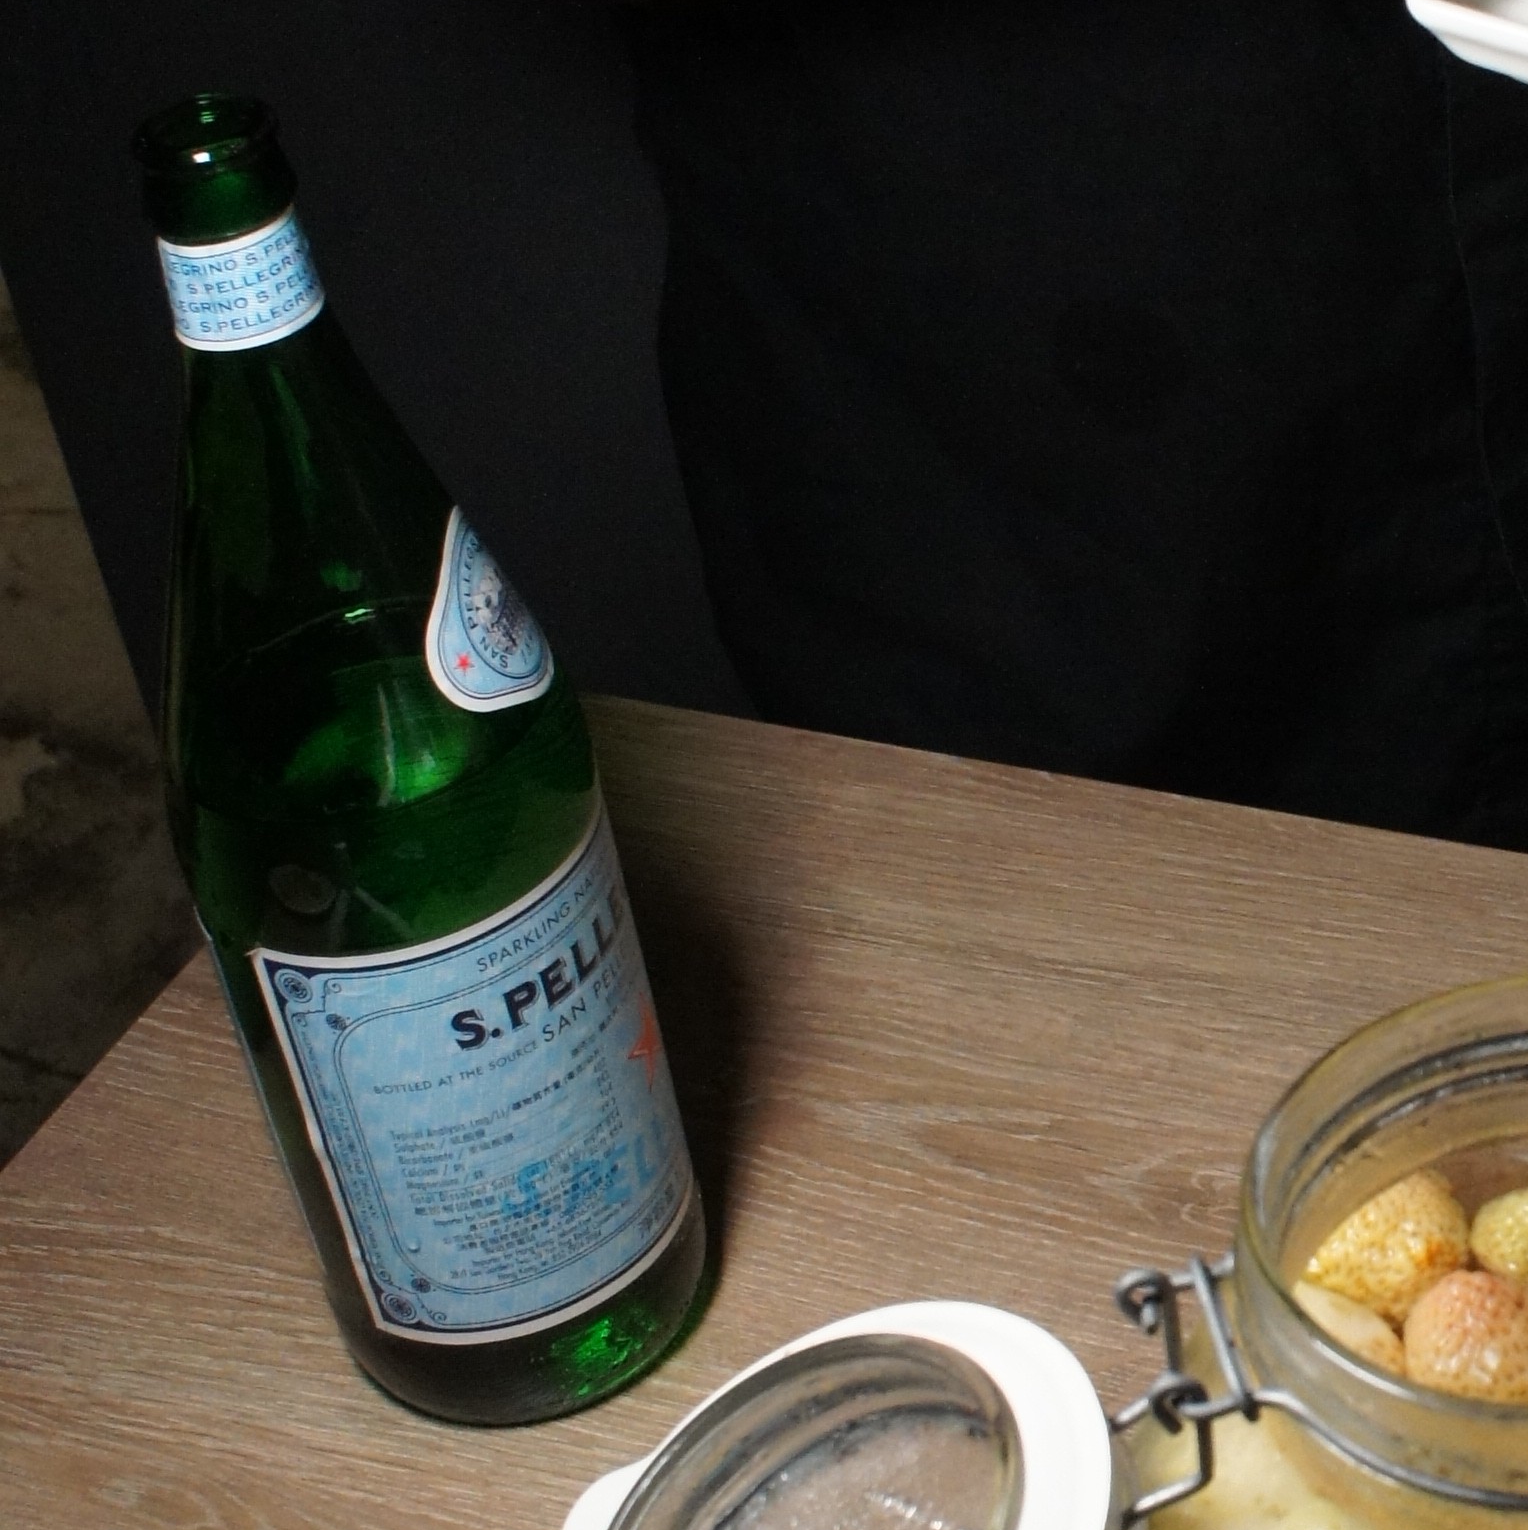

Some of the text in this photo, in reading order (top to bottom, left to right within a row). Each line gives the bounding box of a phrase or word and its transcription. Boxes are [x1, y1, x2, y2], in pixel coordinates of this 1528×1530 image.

[479, 635, 508, 669] SAN
[477, 900, 570, 972] SPARKLING
[373, 1080, 432, 1094] BOTTLED
[438, 1075, 453, 1087] AT
[459, 1066, 483, 1080] THE
[488, 1040, 538, 1071] SOURCE
[542, 999, 587, 1043] SAN
